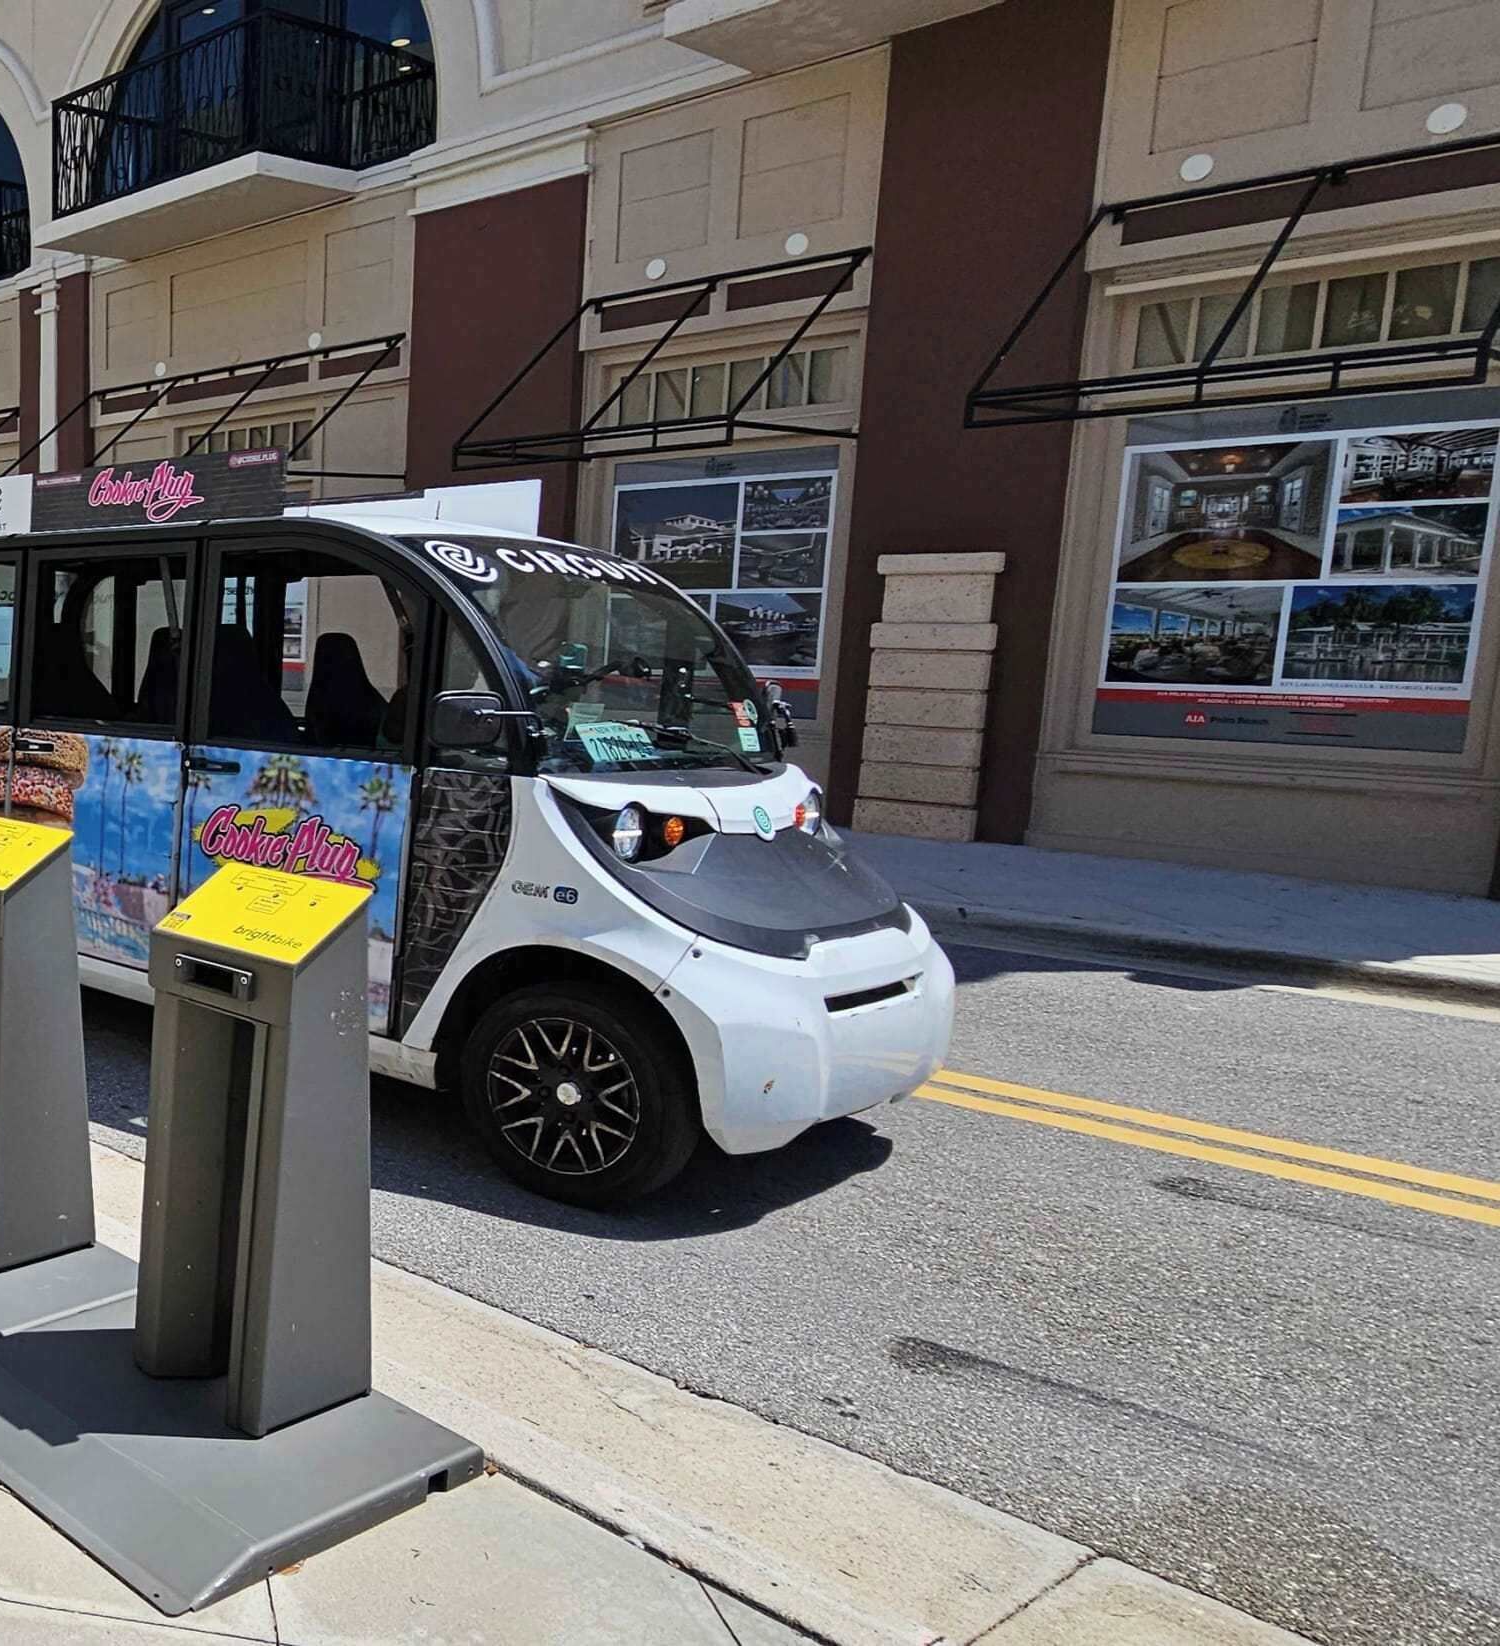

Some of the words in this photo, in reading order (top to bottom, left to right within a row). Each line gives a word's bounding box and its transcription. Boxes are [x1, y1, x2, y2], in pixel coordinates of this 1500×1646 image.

[88, 467, 149, 507] Cookie
[142, 461, 205, 522] Plug
[496, 548, 657, 585] CIRCUIT
[1185, 715, 1205, 723] AIA
[201, 805, 289, 867] Cookie
[283, 816, 375, 889] Plug
[555, 889, 576, 903] e6
[233, 925, 302, 949] brightbike
